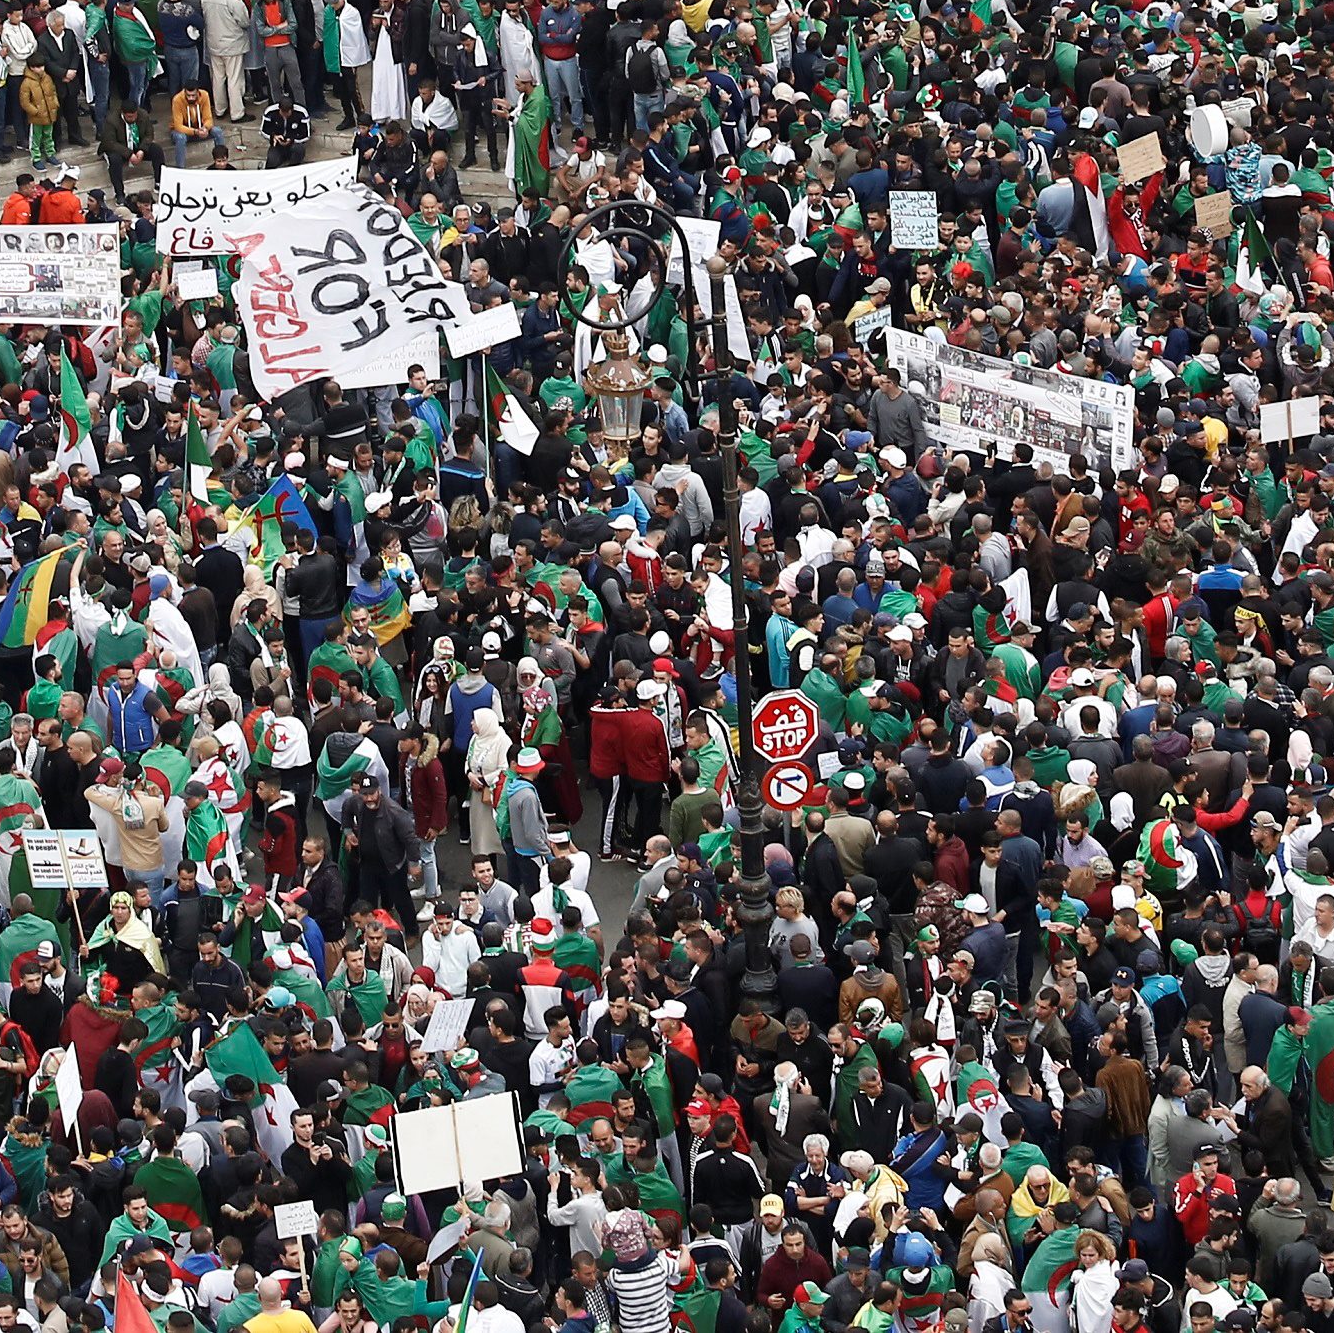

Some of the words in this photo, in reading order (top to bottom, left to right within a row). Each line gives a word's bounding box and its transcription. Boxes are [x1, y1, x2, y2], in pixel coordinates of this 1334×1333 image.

[157, 182, 219, 224] ترحلو
[219, 185, 274, 224] يعني
[285, 167, 354, 209] تحلو
[289, 228, 392, 353] FOR
[759, 702, 810, 735] قف
[762, 728, 808, 753] STOP
